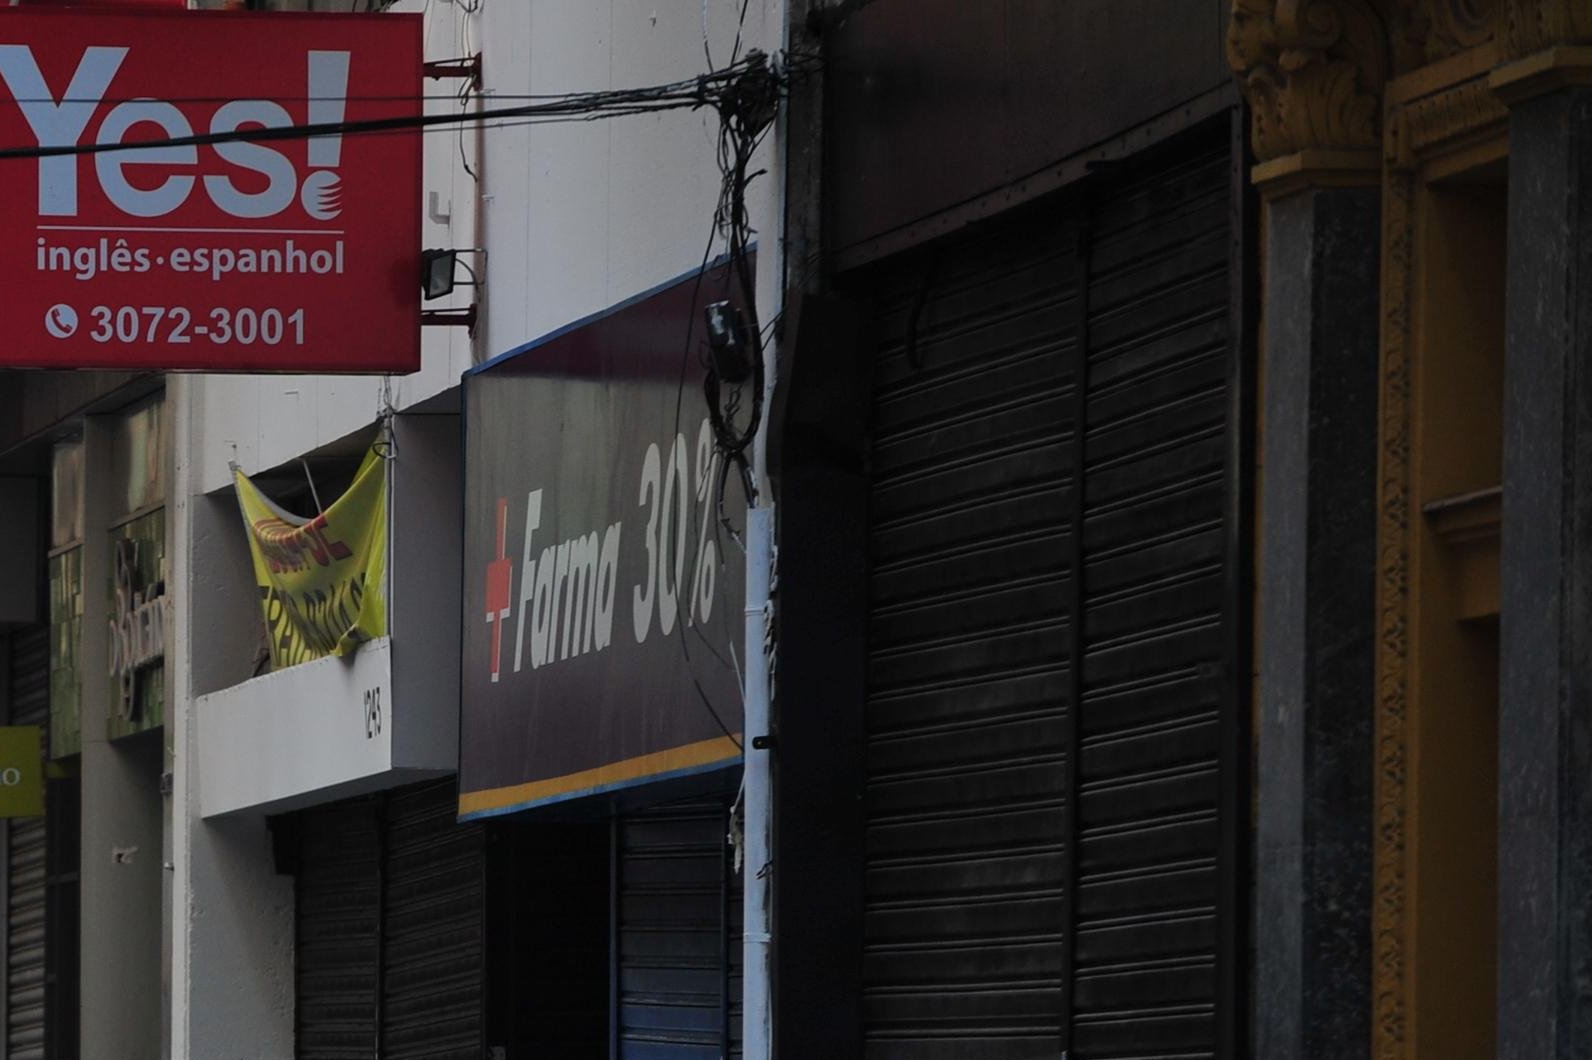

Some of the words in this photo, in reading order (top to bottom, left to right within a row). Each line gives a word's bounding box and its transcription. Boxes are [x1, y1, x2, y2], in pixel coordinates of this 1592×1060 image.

[36, 237, 151, 281] inglês
[169, 239, 344, 281] espanhol
[89, 305, 305, 345] 3072-3001
[513, 488, 622, 673] Farma
[632, 417, 719, 644] 30%
